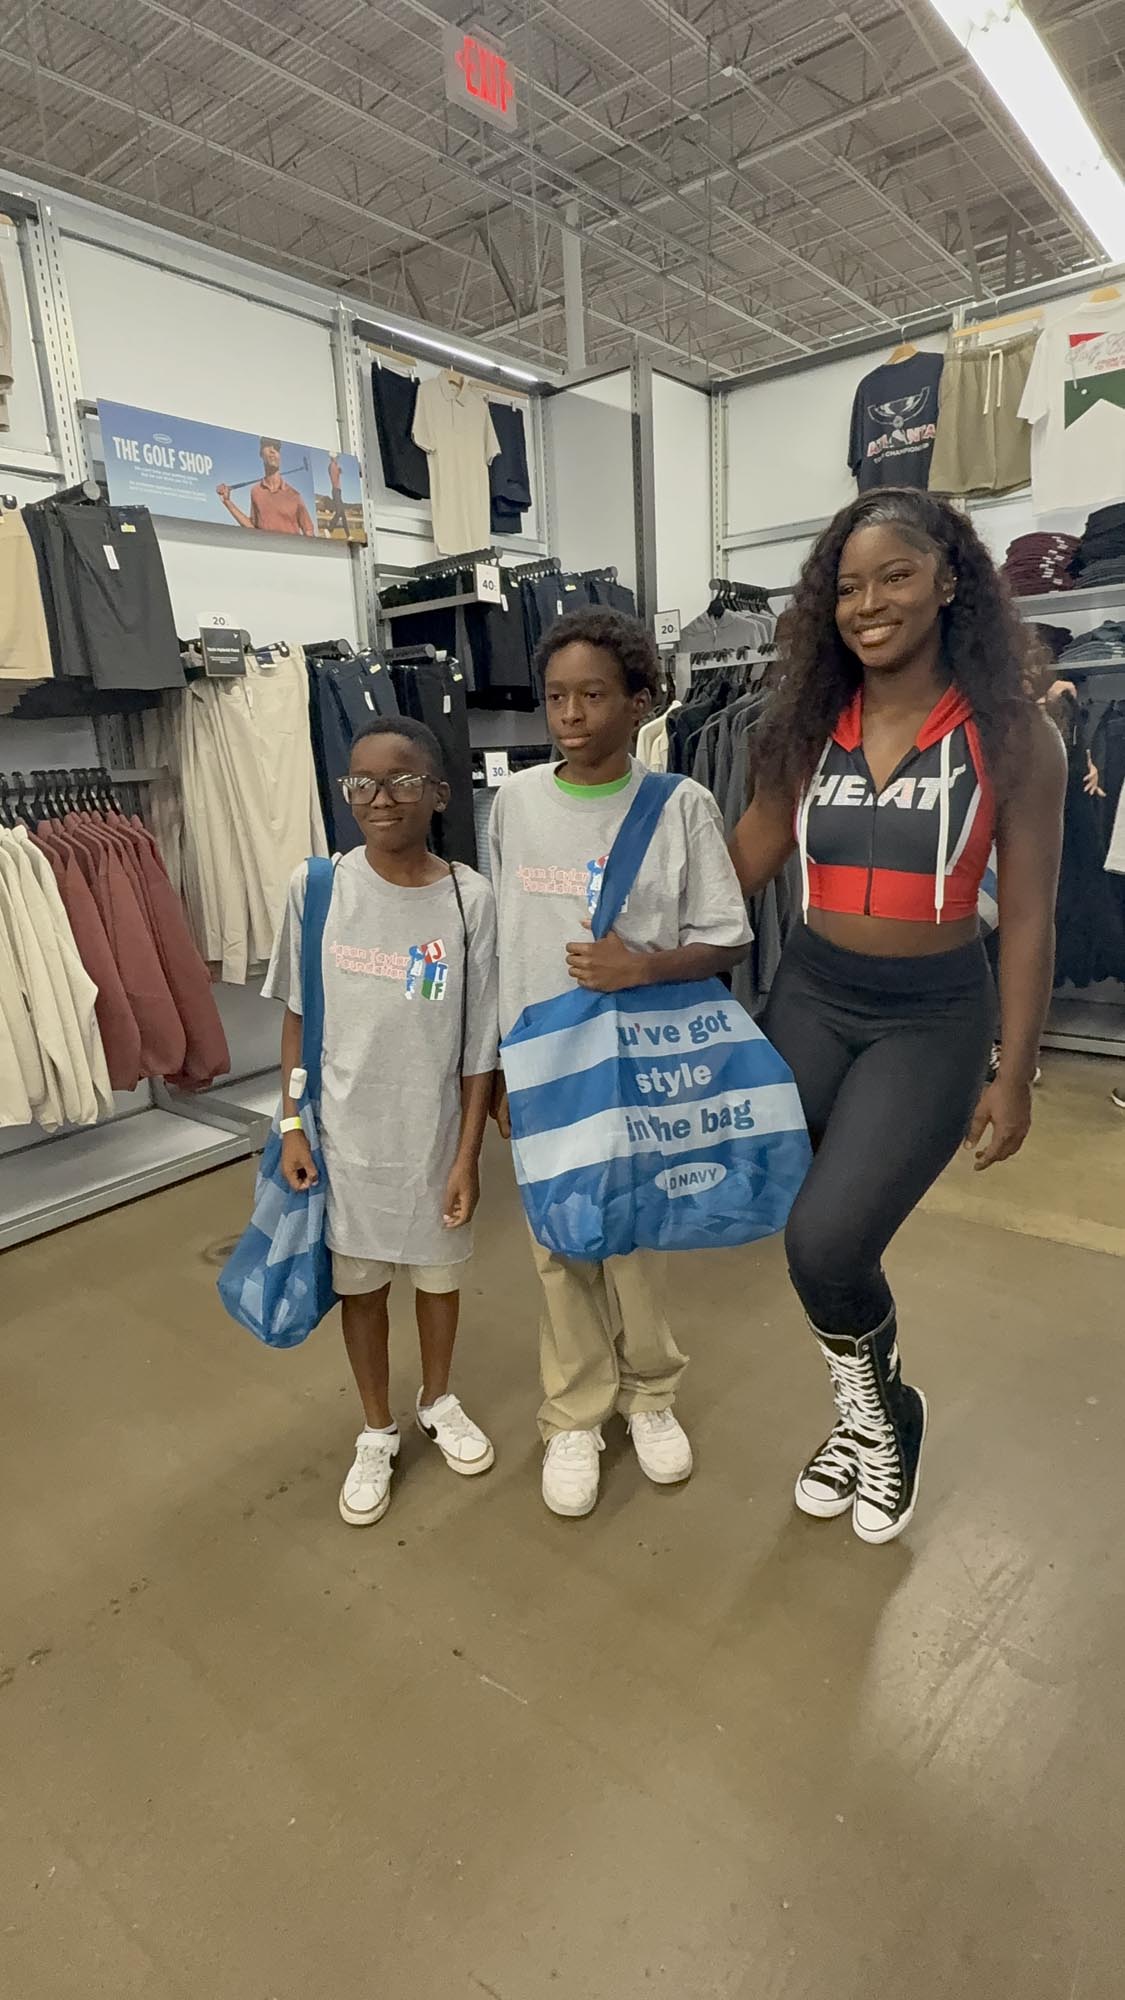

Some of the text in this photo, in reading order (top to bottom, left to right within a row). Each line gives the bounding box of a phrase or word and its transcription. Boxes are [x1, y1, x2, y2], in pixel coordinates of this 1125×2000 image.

[464, 35, 507, 112] EXIT
[112, 436, 141, 463] THE
[143, 443, 176, 469] GOLF
[178, 450, 213, 476] SHOP
[482, 579, 494, 591] 40
[212, 616, 226, 626] 20
[661, 624, 674, 635] 20
[492, 767, 504, 777] 30
[812, 767, 962, 811] HEAT
[688, 1010, 731, 1043] got
[635, 1062, 712, 1098] style
[626, 1115, 648, 1143] in
[701, 1100, 755, 1133] bag
[679, 1167, 717, 1187] NAVY
